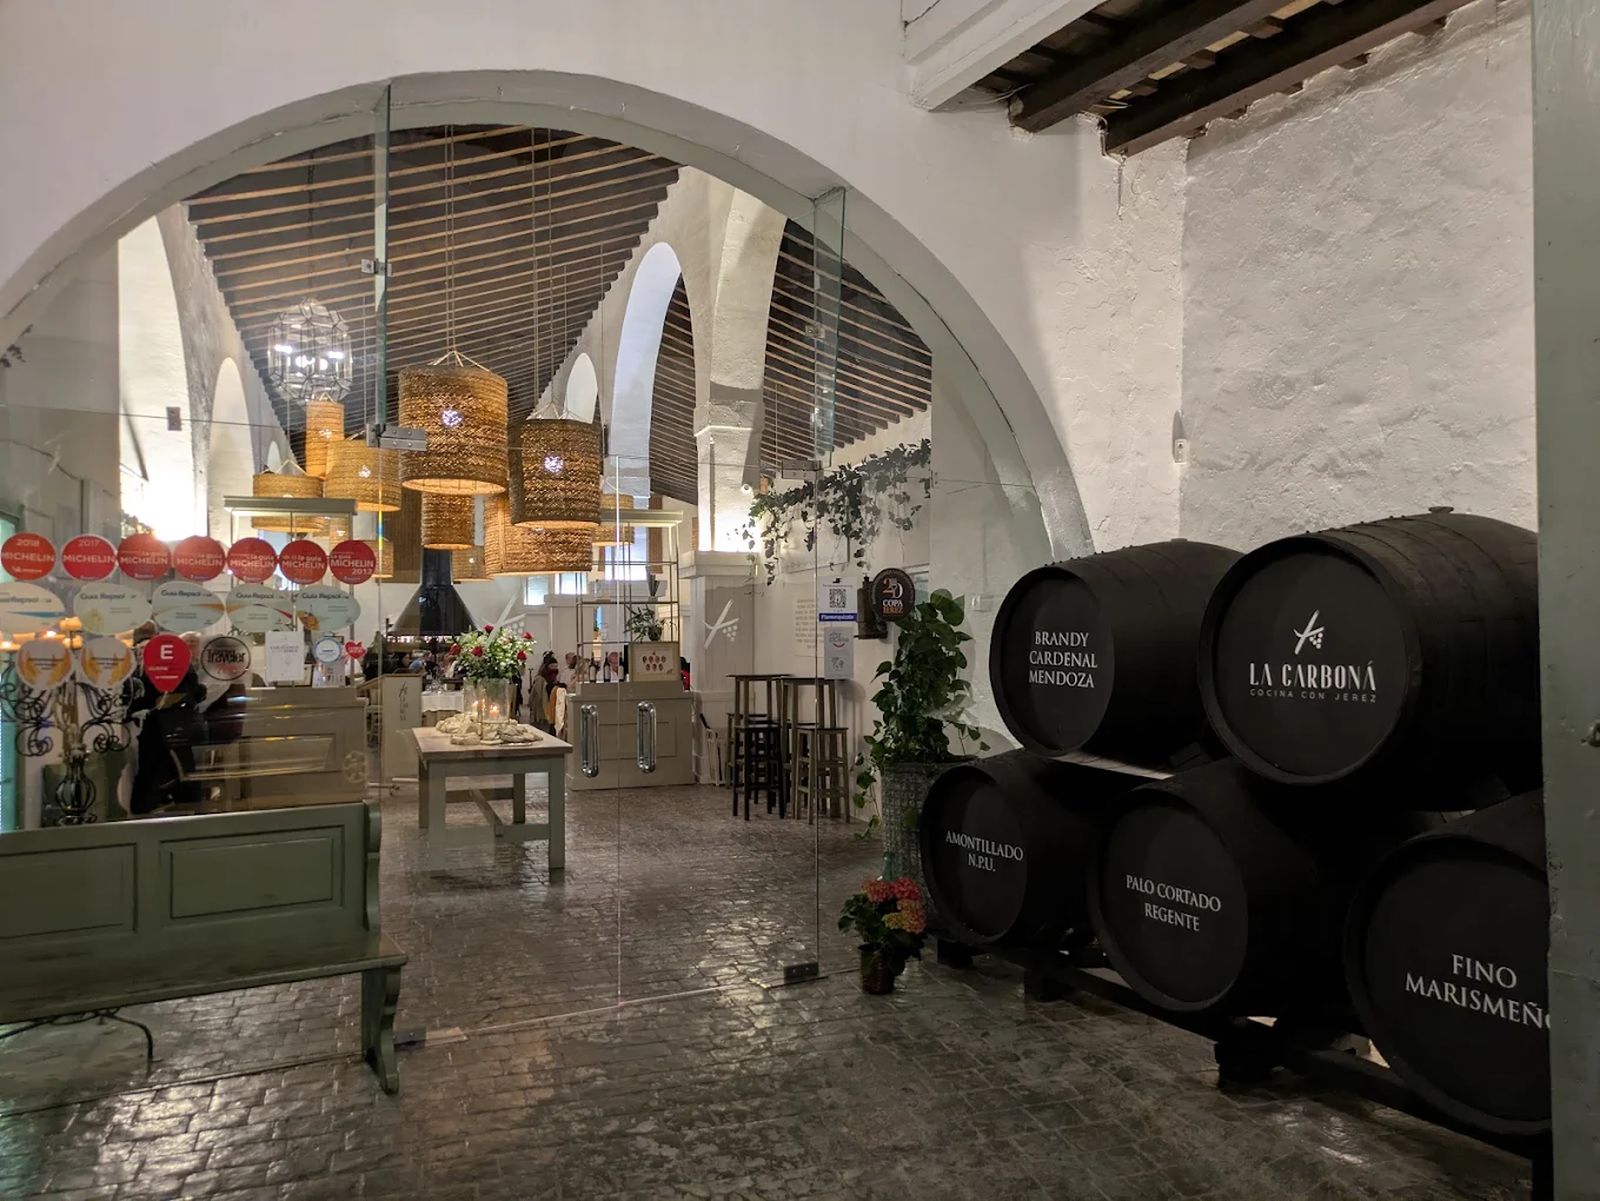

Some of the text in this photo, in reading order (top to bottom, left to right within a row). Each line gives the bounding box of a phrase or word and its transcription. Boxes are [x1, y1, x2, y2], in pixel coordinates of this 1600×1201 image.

[2, 552, 55, 562] MICHELIN
[63, 554, 116, 563] MICHELIN
[120, 556, 168, 565] MICHELIN
[177, 558, 222, 567] MICHELIN
[230, 560, 275, 568] MICHELIN
[281, 560, 325, 569] MICHELIN
[330, 559, 374, 568] MICHELIN
[882, 599, 903, 607] COPA
[1035, 631, 1089, 647] BRANDY
[160, 644, 174, 660] E
[1029, 650, 1098, 668] CARDENAL
[1029, 669, 1095, 688] MENDOZA
[1250, 660, 1376, 691] LA CARBONÁ
[1250, 688, 1376, 703] COCINA CON JEREZ
[945, 830, 1023, 861] AMONTILLADO
[968, 853, 996, 872] N.P.U.
[1126, 874, 1221, 912] PALO CORTADO
[1144, 902, 1200, 931] REGENTE
[1452, 953, 1517, 989] FINO
